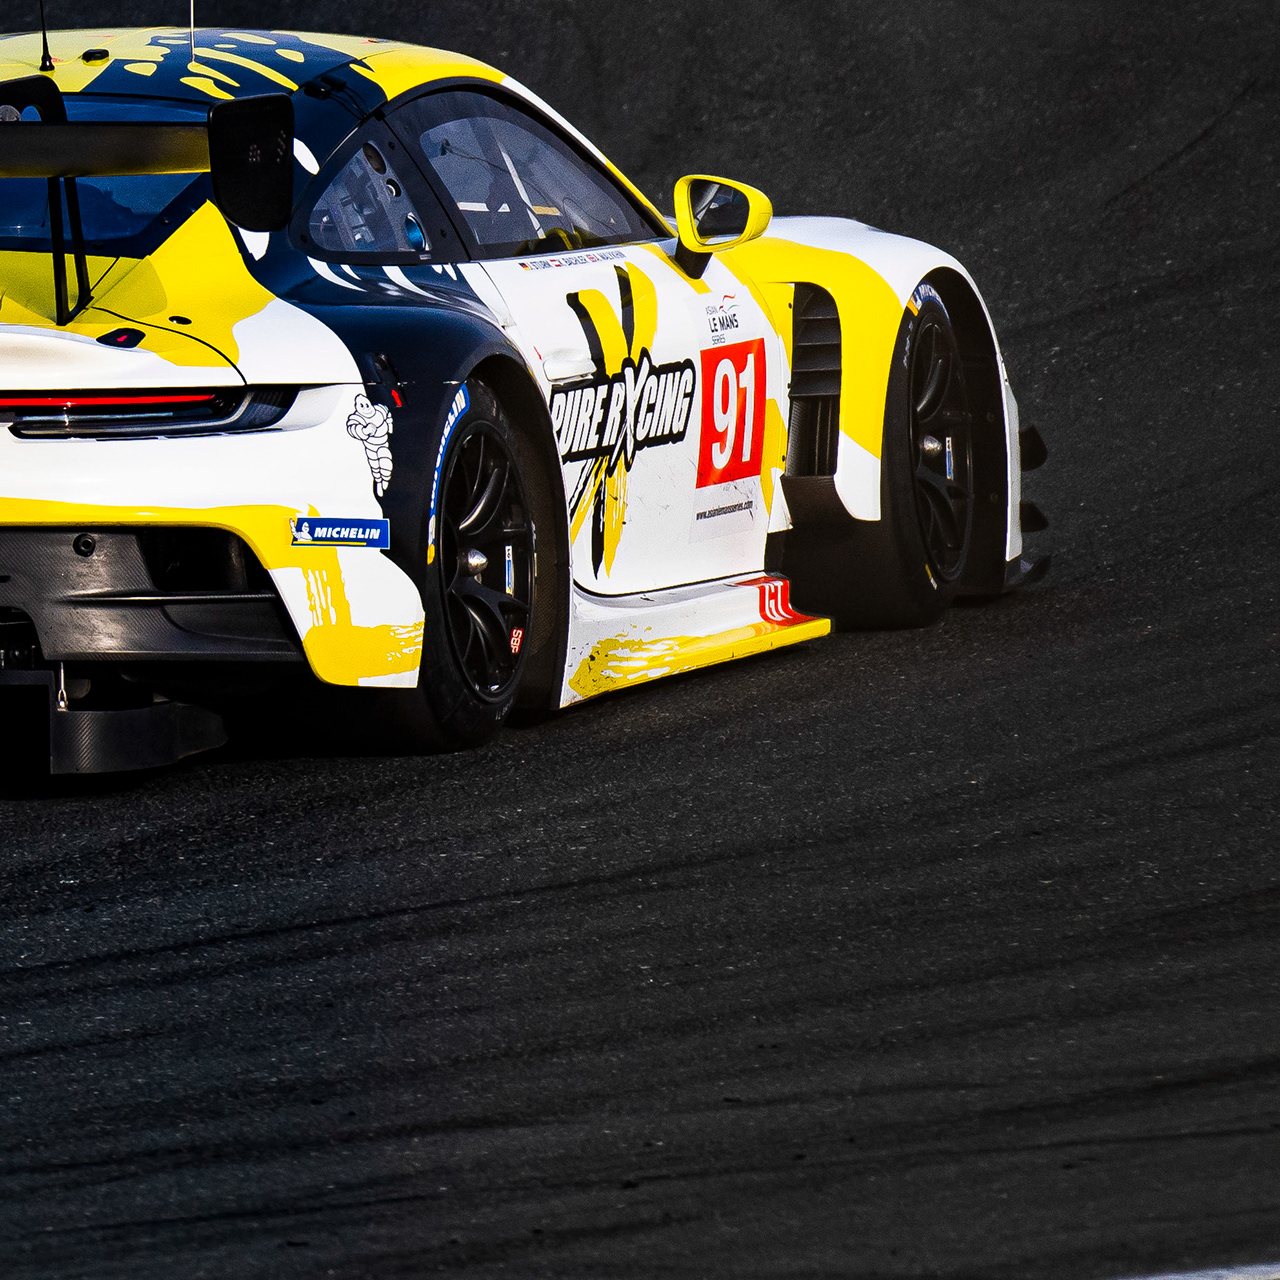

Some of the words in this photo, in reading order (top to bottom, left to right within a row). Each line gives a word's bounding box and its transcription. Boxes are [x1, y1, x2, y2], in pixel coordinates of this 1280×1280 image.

[708, 317, 719, 333] LE
[718, 313, 739, 332] MANS
[551, 384, 609, 456] PURE
[711, 353, 755, 470] 91
[313, 527, 381, 540] MICHELIN
[765, 580, 793, 621] GT
